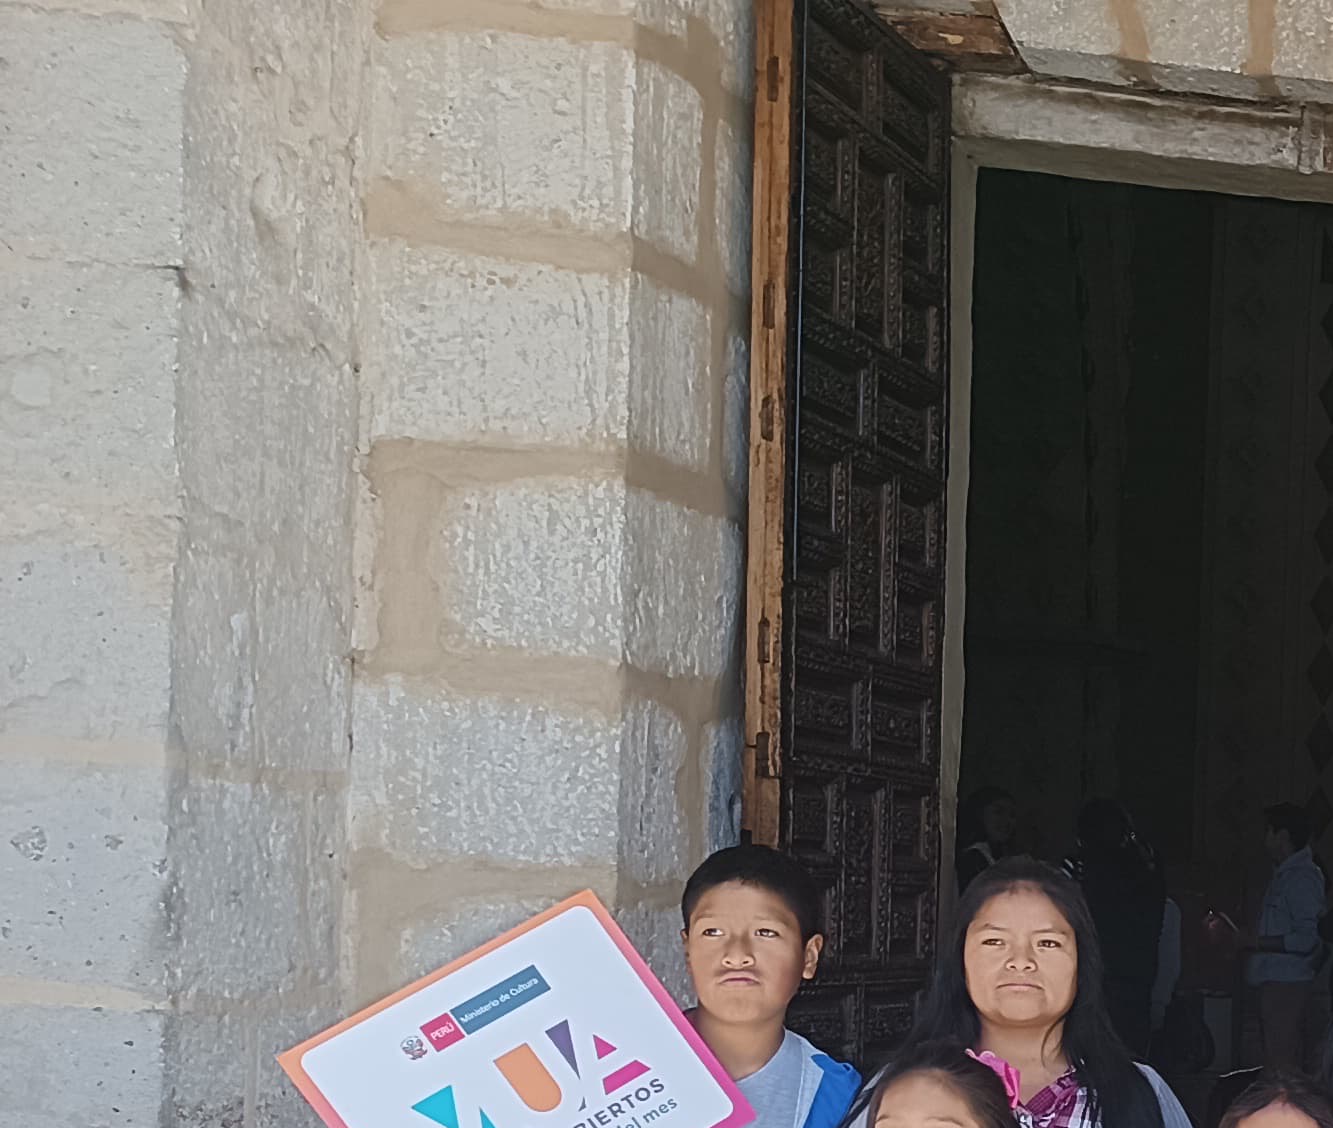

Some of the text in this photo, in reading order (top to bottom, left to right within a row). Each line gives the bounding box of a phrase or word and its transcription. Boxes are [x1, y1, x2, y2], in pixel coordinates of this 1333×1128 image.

[460, 977, 539, 1024] Ministerio de Cultura
[430, 1022, 455, 1041] PERÚ
[643, 1097, 678, 1125] mes
